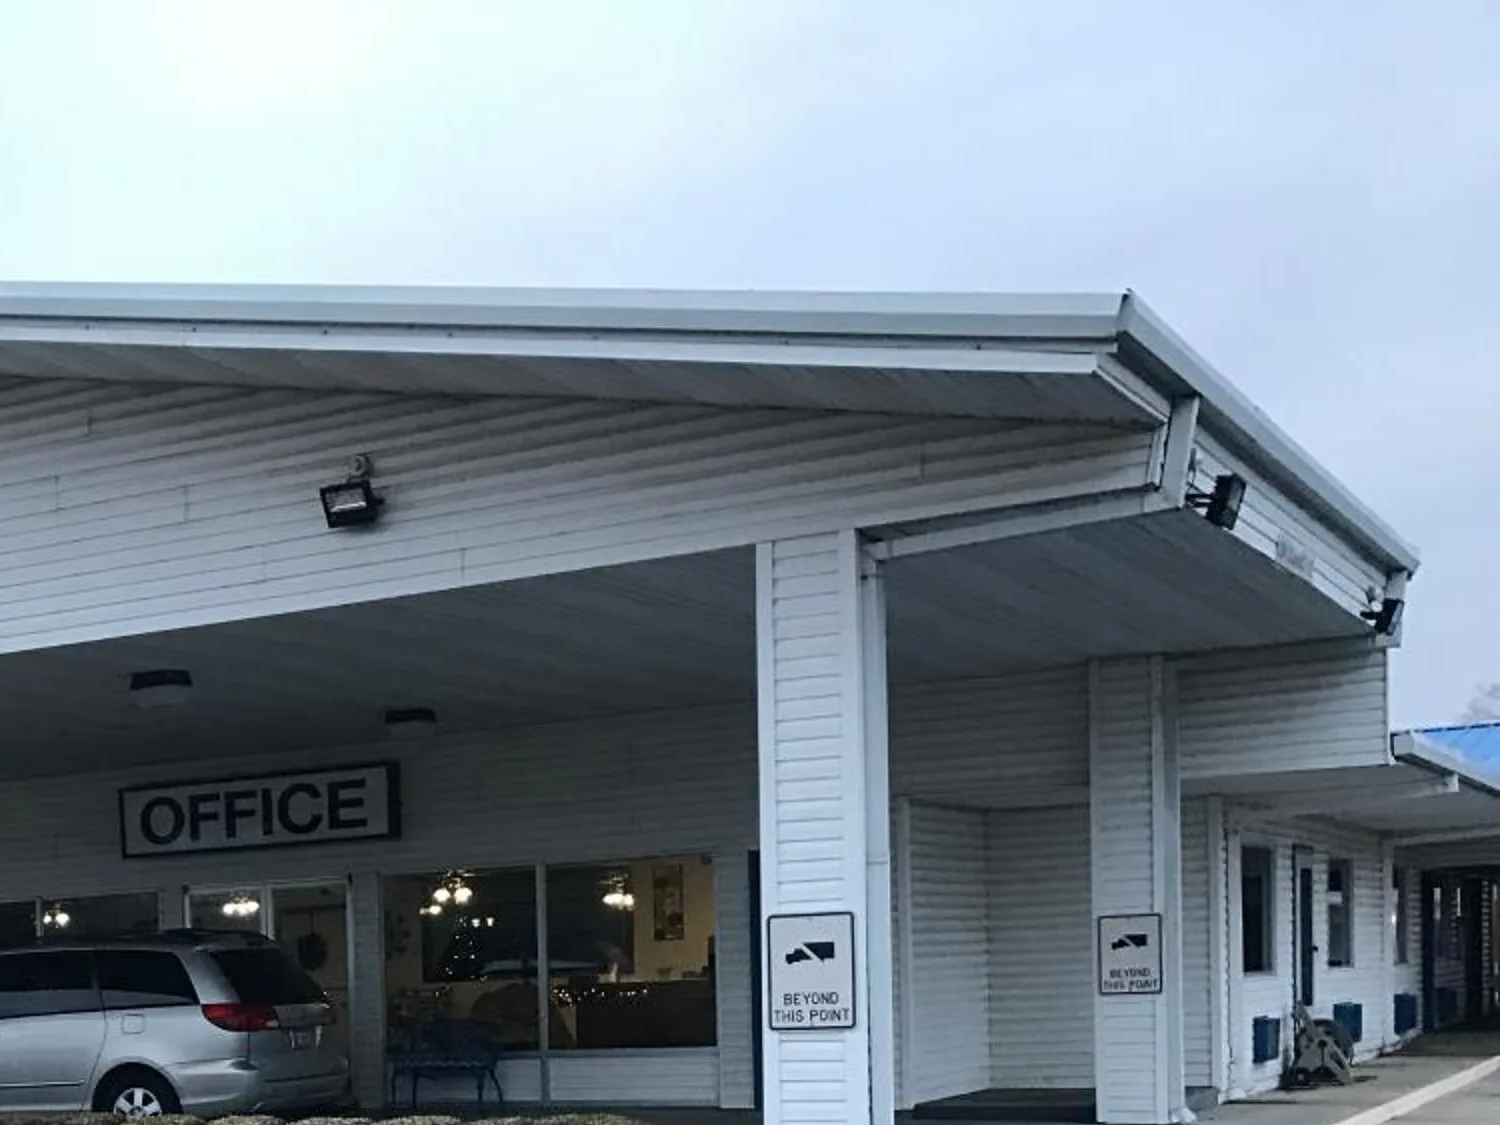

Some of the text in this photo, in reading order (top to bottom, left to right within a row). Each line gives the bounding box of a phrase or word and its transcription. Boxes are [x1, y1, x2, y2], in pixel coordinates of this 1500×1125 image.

[140, 778, 368, 845] OFFICE
[783, 991, 839, 1006] BEYOND
[774, 1007, 850, 1023] THIS POINT
